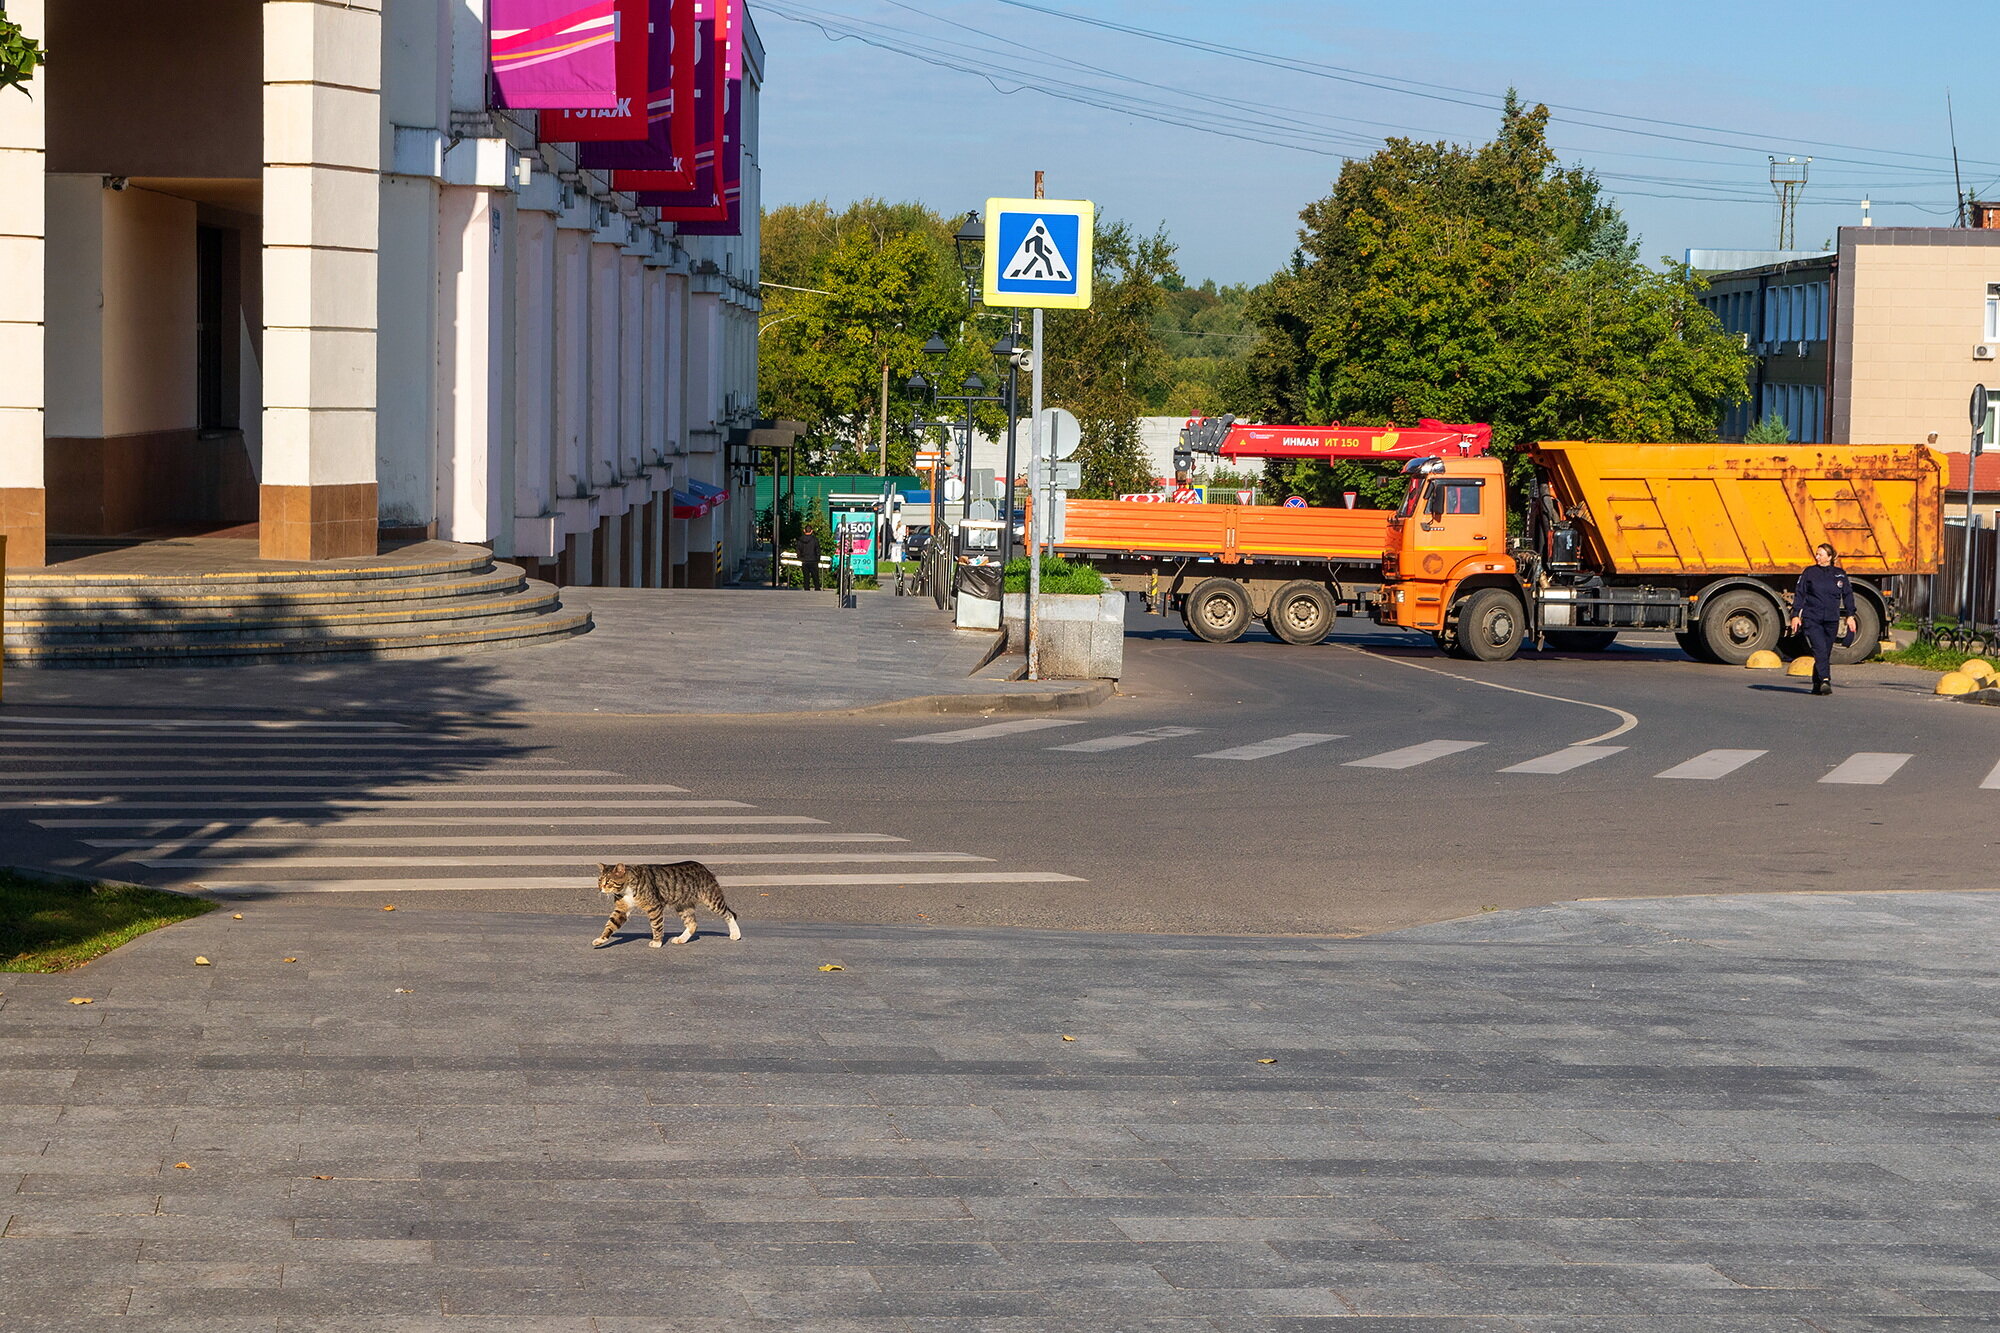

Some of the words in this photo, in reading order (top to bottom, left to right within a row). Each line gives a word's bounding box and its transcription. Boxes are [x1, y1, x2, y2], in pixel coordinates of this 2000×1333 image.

[1282, 437, 1320, 447] ИНМАН
[1325, 438, 1339, 447] ИТ
[1341, 438, 1360, 447] 150
